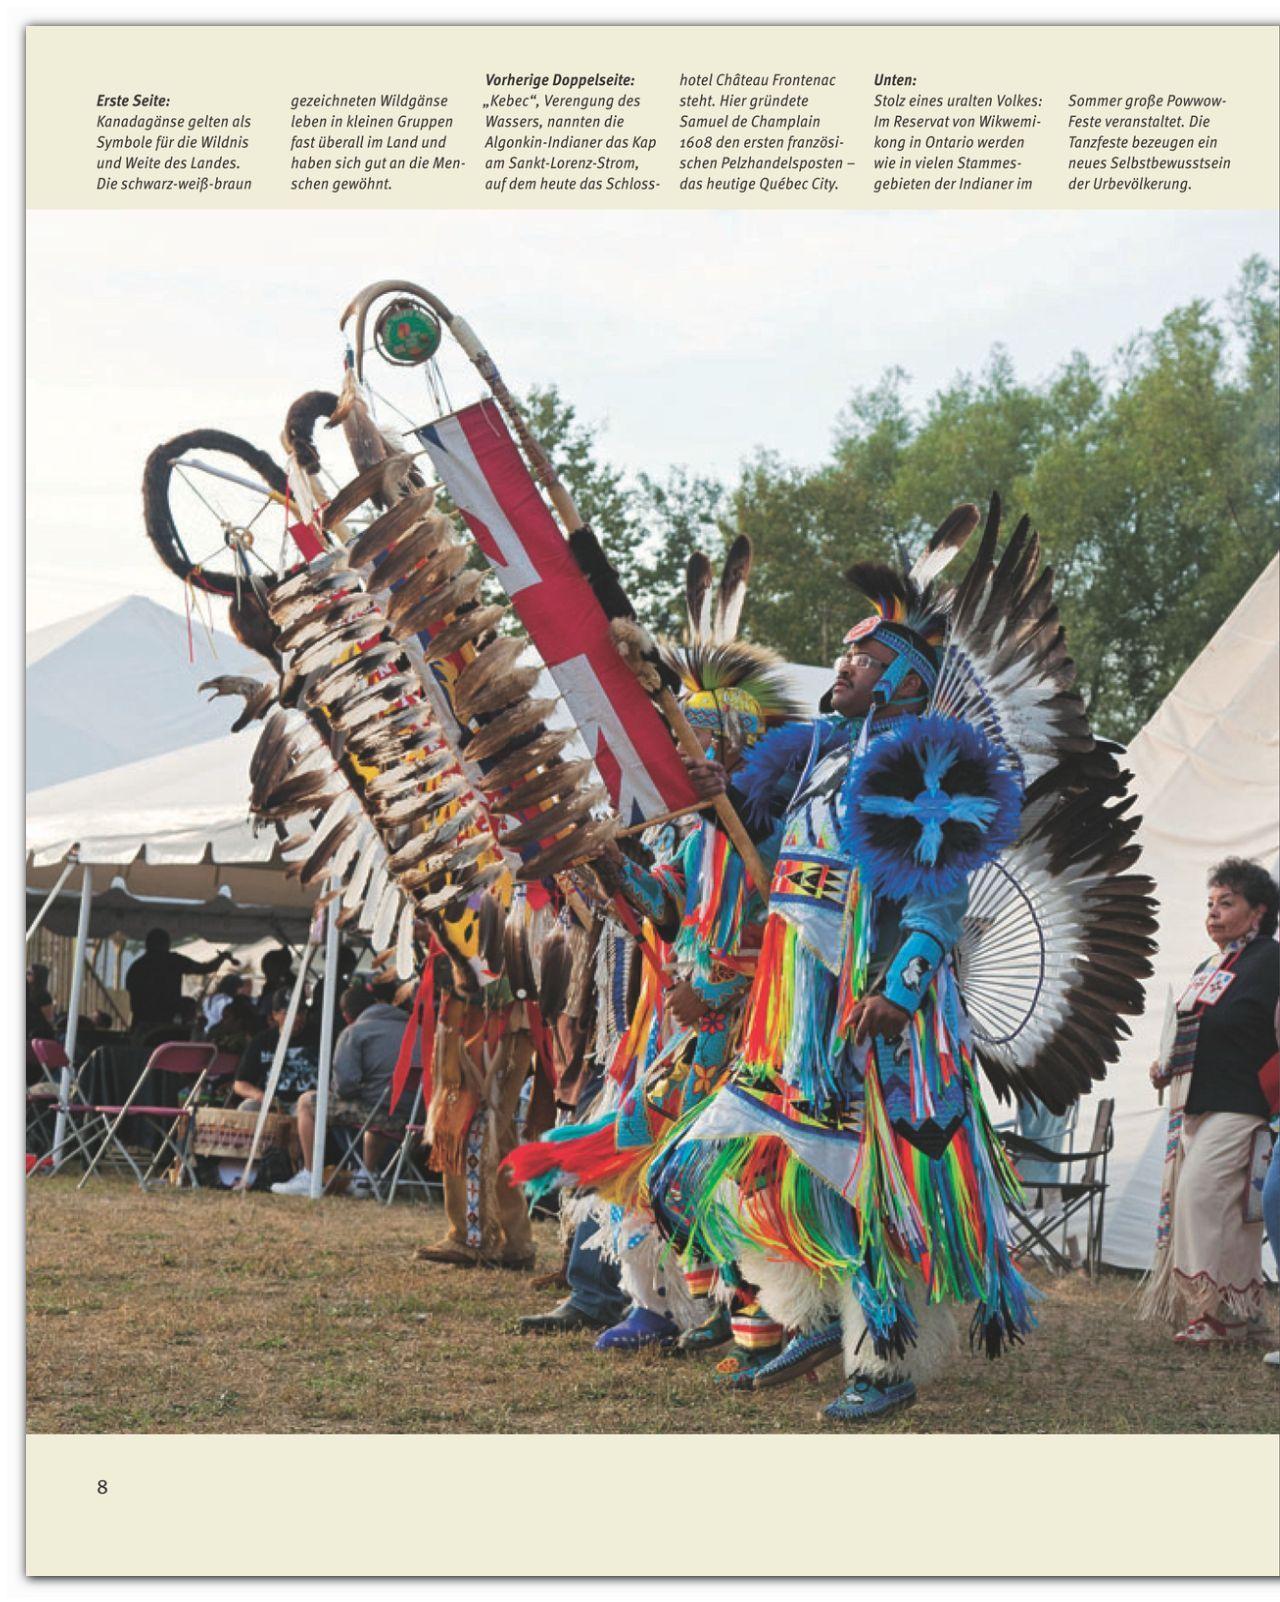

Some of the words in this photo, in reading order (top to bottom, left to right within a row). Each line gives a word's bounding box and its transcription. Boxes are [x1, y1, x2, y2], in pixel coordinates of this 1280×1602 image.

[485, 72, 550, 90] Vorherige
[552, 72, 636, 90] Doppelseite:
[679, 72, 714, 87] hotel
[715, 72, 769, 87] Château
[771, 73, 837, 87] Frontenac
[873, 73, 917, 87] Unten:
[96, 93, 130, 108] Erste
[131, 93, 171, 108] Seite:
[290, 93, 377, 111] gezeichneten
[380, 93, 449, 111] Wildgänse
[873, 93, 907, 108] Stolz
[908, 93, 944, 108] eines
[946, 93, 993, 108] uralten
[996, 93, 1043, 108] Volkes:
[1067, 93, 1124, 108] Sommer
[1124, 93, 1164, 111] große
[1166, 94, 1227, 108] Powwow-
[485, 114, 543, 130] Wassers,
[547, 115, 601, 128] nannten
[603, 114, 625, 128] die
[679, 114, 729, 129] Samuel
[731, 114, 748, 128] de
[750, 114, 821, 131] Champlain
[96, 134, 153, 152] Symbole
[154, 134, 175, 152] für
[176, 134, 198, 149] die
[201, 135, 249, 149] Wildnis
[289, 134, 316, 152] fast
[318, 135, 365, 149] überall
[366, 135, 384, 149] im
[386, 134, 419, 149] Land
[421, 135, 447, 149] und
[873, 135, 906, 152] kong
[909, 135, 922, 149] in
[925, 135, 974, 149] Ontario
[977, 135, 1025, 149] werden
[1068, 134, 1129, 152] Tanzfeste
[1131, 135, 1195, 152] bezeugen
[1197, 135, 1218, 149] ein
[484, 159, 505, 170] am
[508, 155, 639, 171] Sankt-Lorenz-Strom,
[678, 155, 718, 170] schen
[720, 155, 843, 173] Pelzhandelsposten
[96, 176, 118, 191] Die
[120, 176, 252, 193] schwarz-weiß-braun
[290, 176, 329, 191] schen
[331, 176, 392, 194] gewöhnt.
[1068, 176, 1091, 191] der
[1093, 176, 1192, 194] Urbevölkerung.
[96, 1479, 109, 1495] 8
